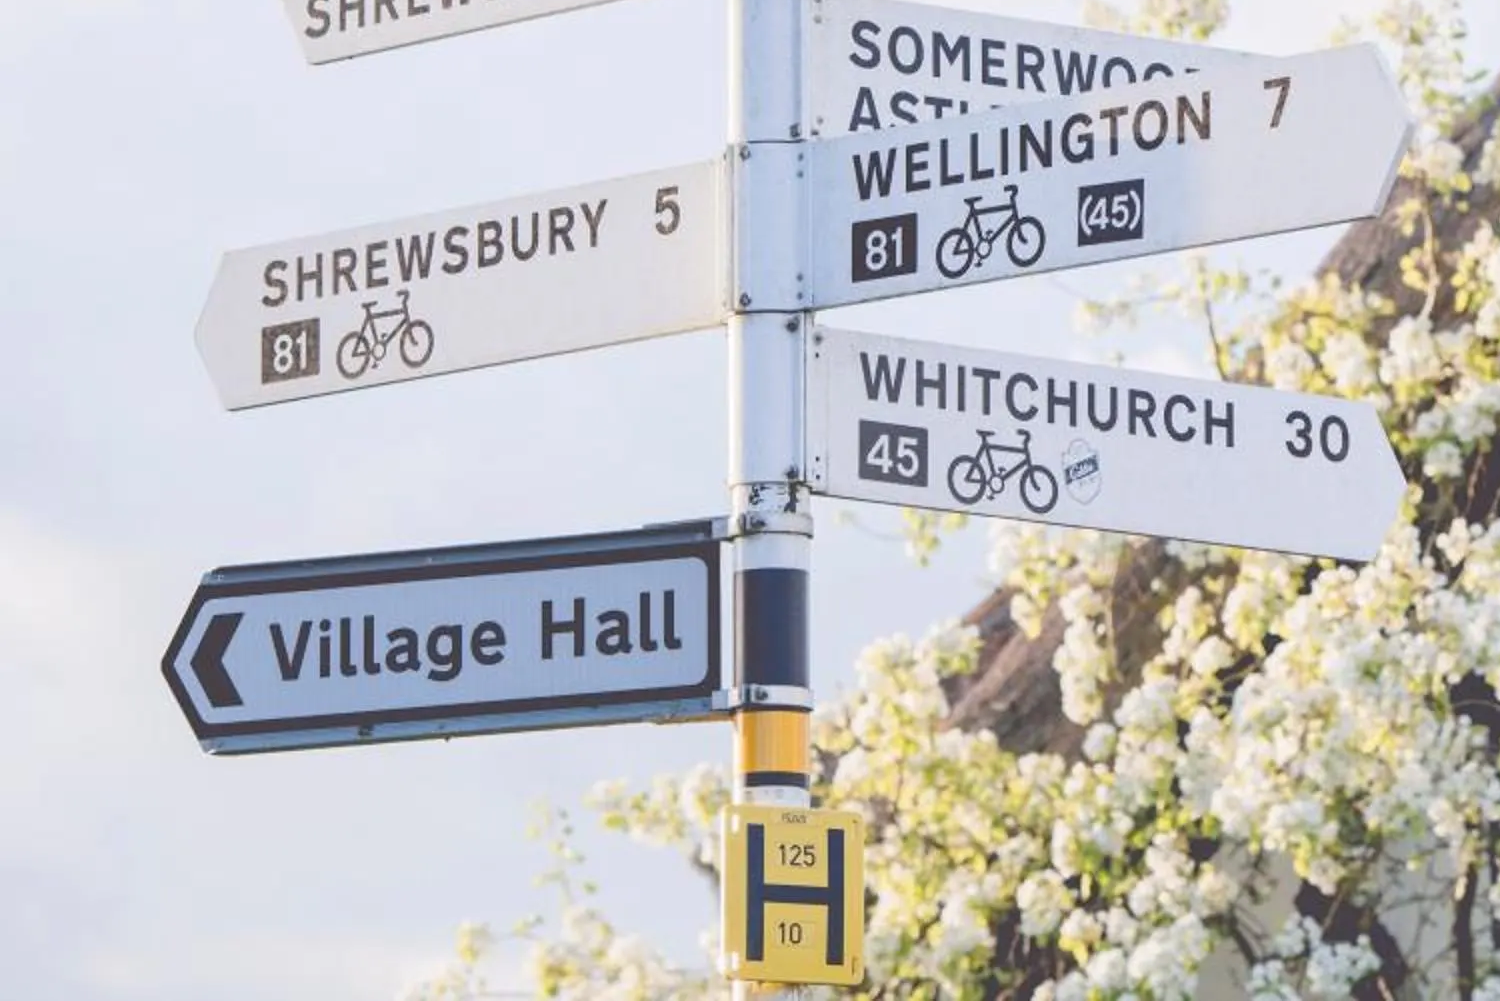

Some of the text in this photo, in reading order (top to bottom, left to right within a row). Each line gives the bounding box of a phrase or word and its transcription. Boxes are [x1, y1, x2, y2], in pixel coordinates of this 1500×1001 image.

[849, 19, 1200, 97] SOMERWO
[852, 76, 1292, 201] WELLINGTON 7
[261, 186, 681, 307] SHREWSBURY 5
[865, 229, 905, 271] 81
[272, 332, 309, 375] 81
[860, 352, 1350, 462] WHITCHURCH 30
[866, 433, 920, 480] 45
[268, 589, 682, 683] Village Hall
[779, 844, 816, 867] 125
[779, 922, 803, 945] 10
